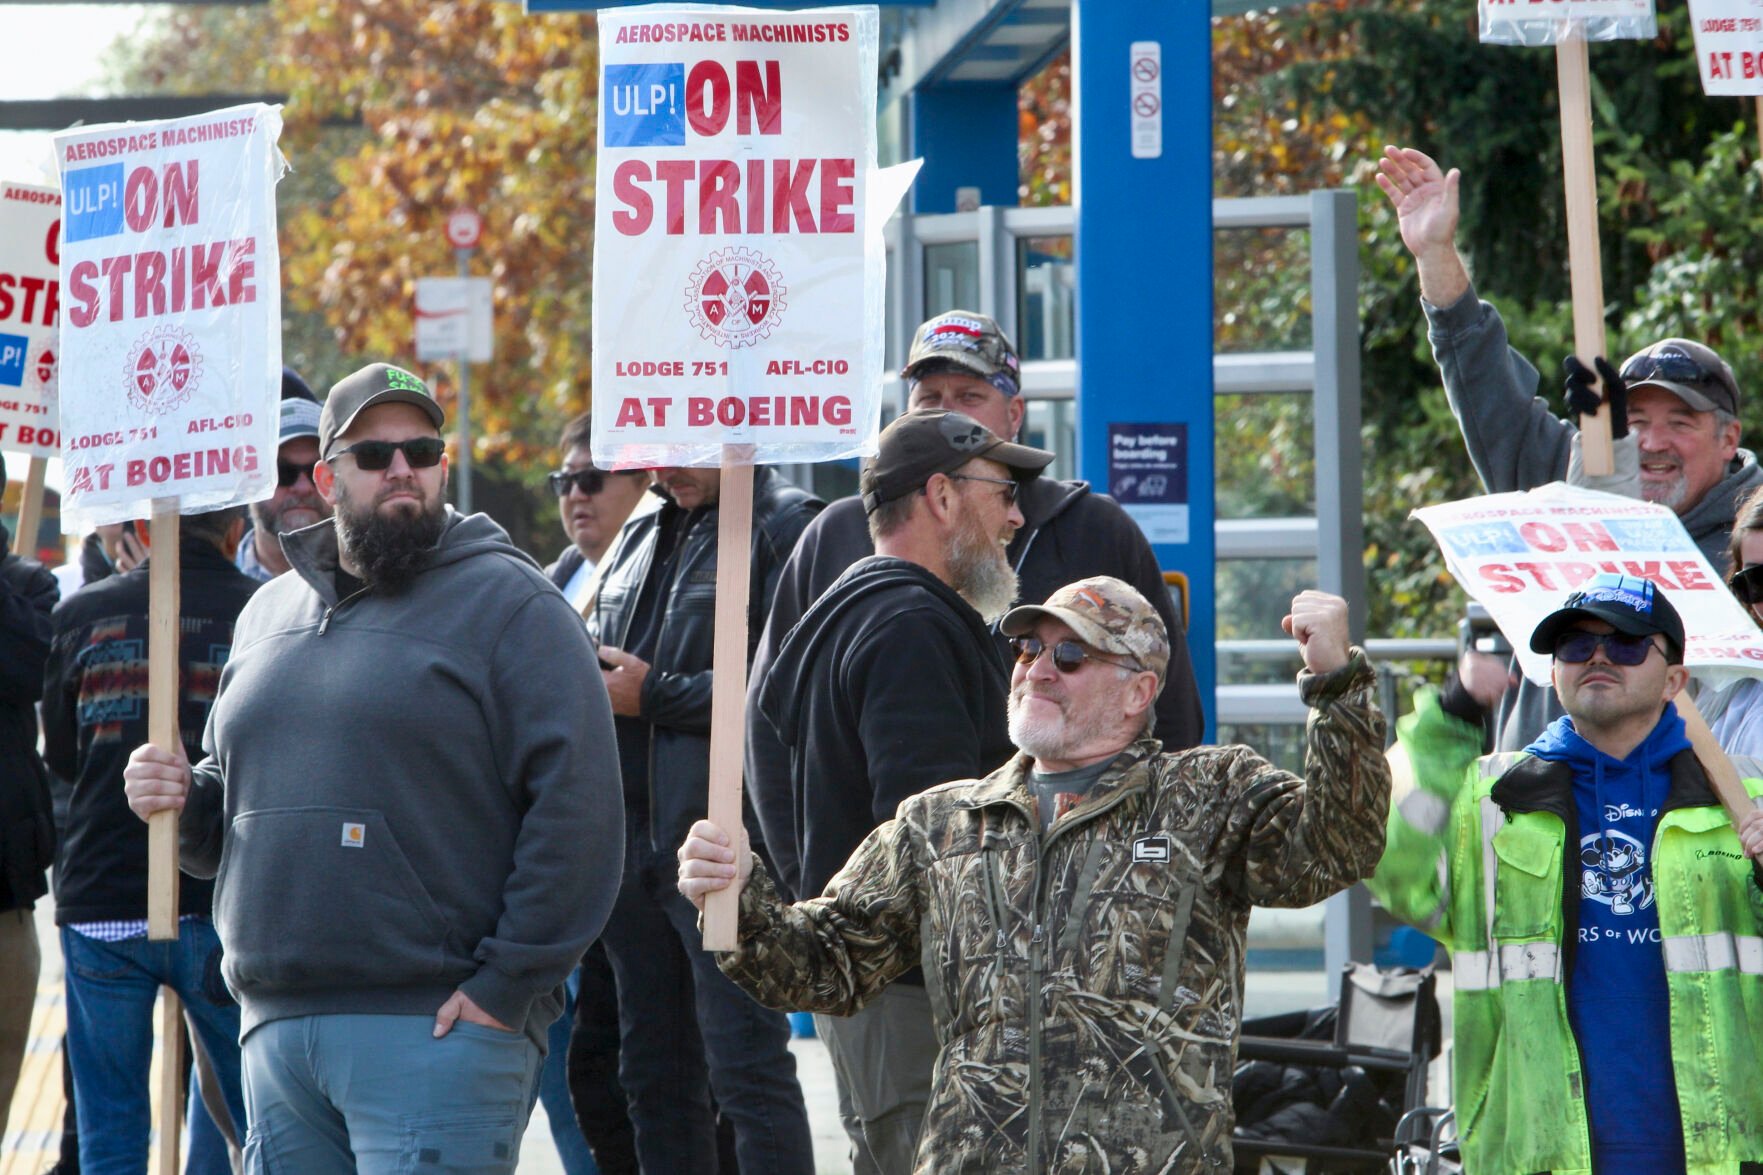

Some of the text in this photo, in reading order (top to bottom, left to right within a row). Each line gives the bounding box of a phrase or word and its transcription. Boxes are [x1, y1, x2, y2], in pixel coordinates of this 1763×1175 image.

[616, 23, 850, 44] AEROSPACE MACHINISTS
[1710, 52, 1732, 79] AT
[613, 84, 676, 116] ULP!
[685, 60, 782, 137] ON
[66, 117, 256, 162] AEROSPACE MACHINISTS
[70, 182, 118, 216] ULP!
[125, 159, 199, 233] ON
[612, 158, 855, 236] STRIKE
[69, 237, 256, 328] STRIKE
[709, 304, 763, 315] A M
[175, 372, 185, 383] M
[616, 361, 728, 376] LODGE 751
[766, 360, 849, 375] AFL-CIO
[24, 403, 48, 415] 751
[615, 395, 852, 427] AT BOEING
[187, 413, 253, 434] AFL-CIO
[71, 426, 158, 450] LODGE 751
[1113, 434, 1177, 448] Pay before
[1113, 448, 1167, 461] boarding
[71, 445, 258, 494] AT BOEING
[1451, 525, 1514, 548] ULP!
[1519, 521, 1620, 553] ON
[1708, 850, 1742, 860] BOEING
